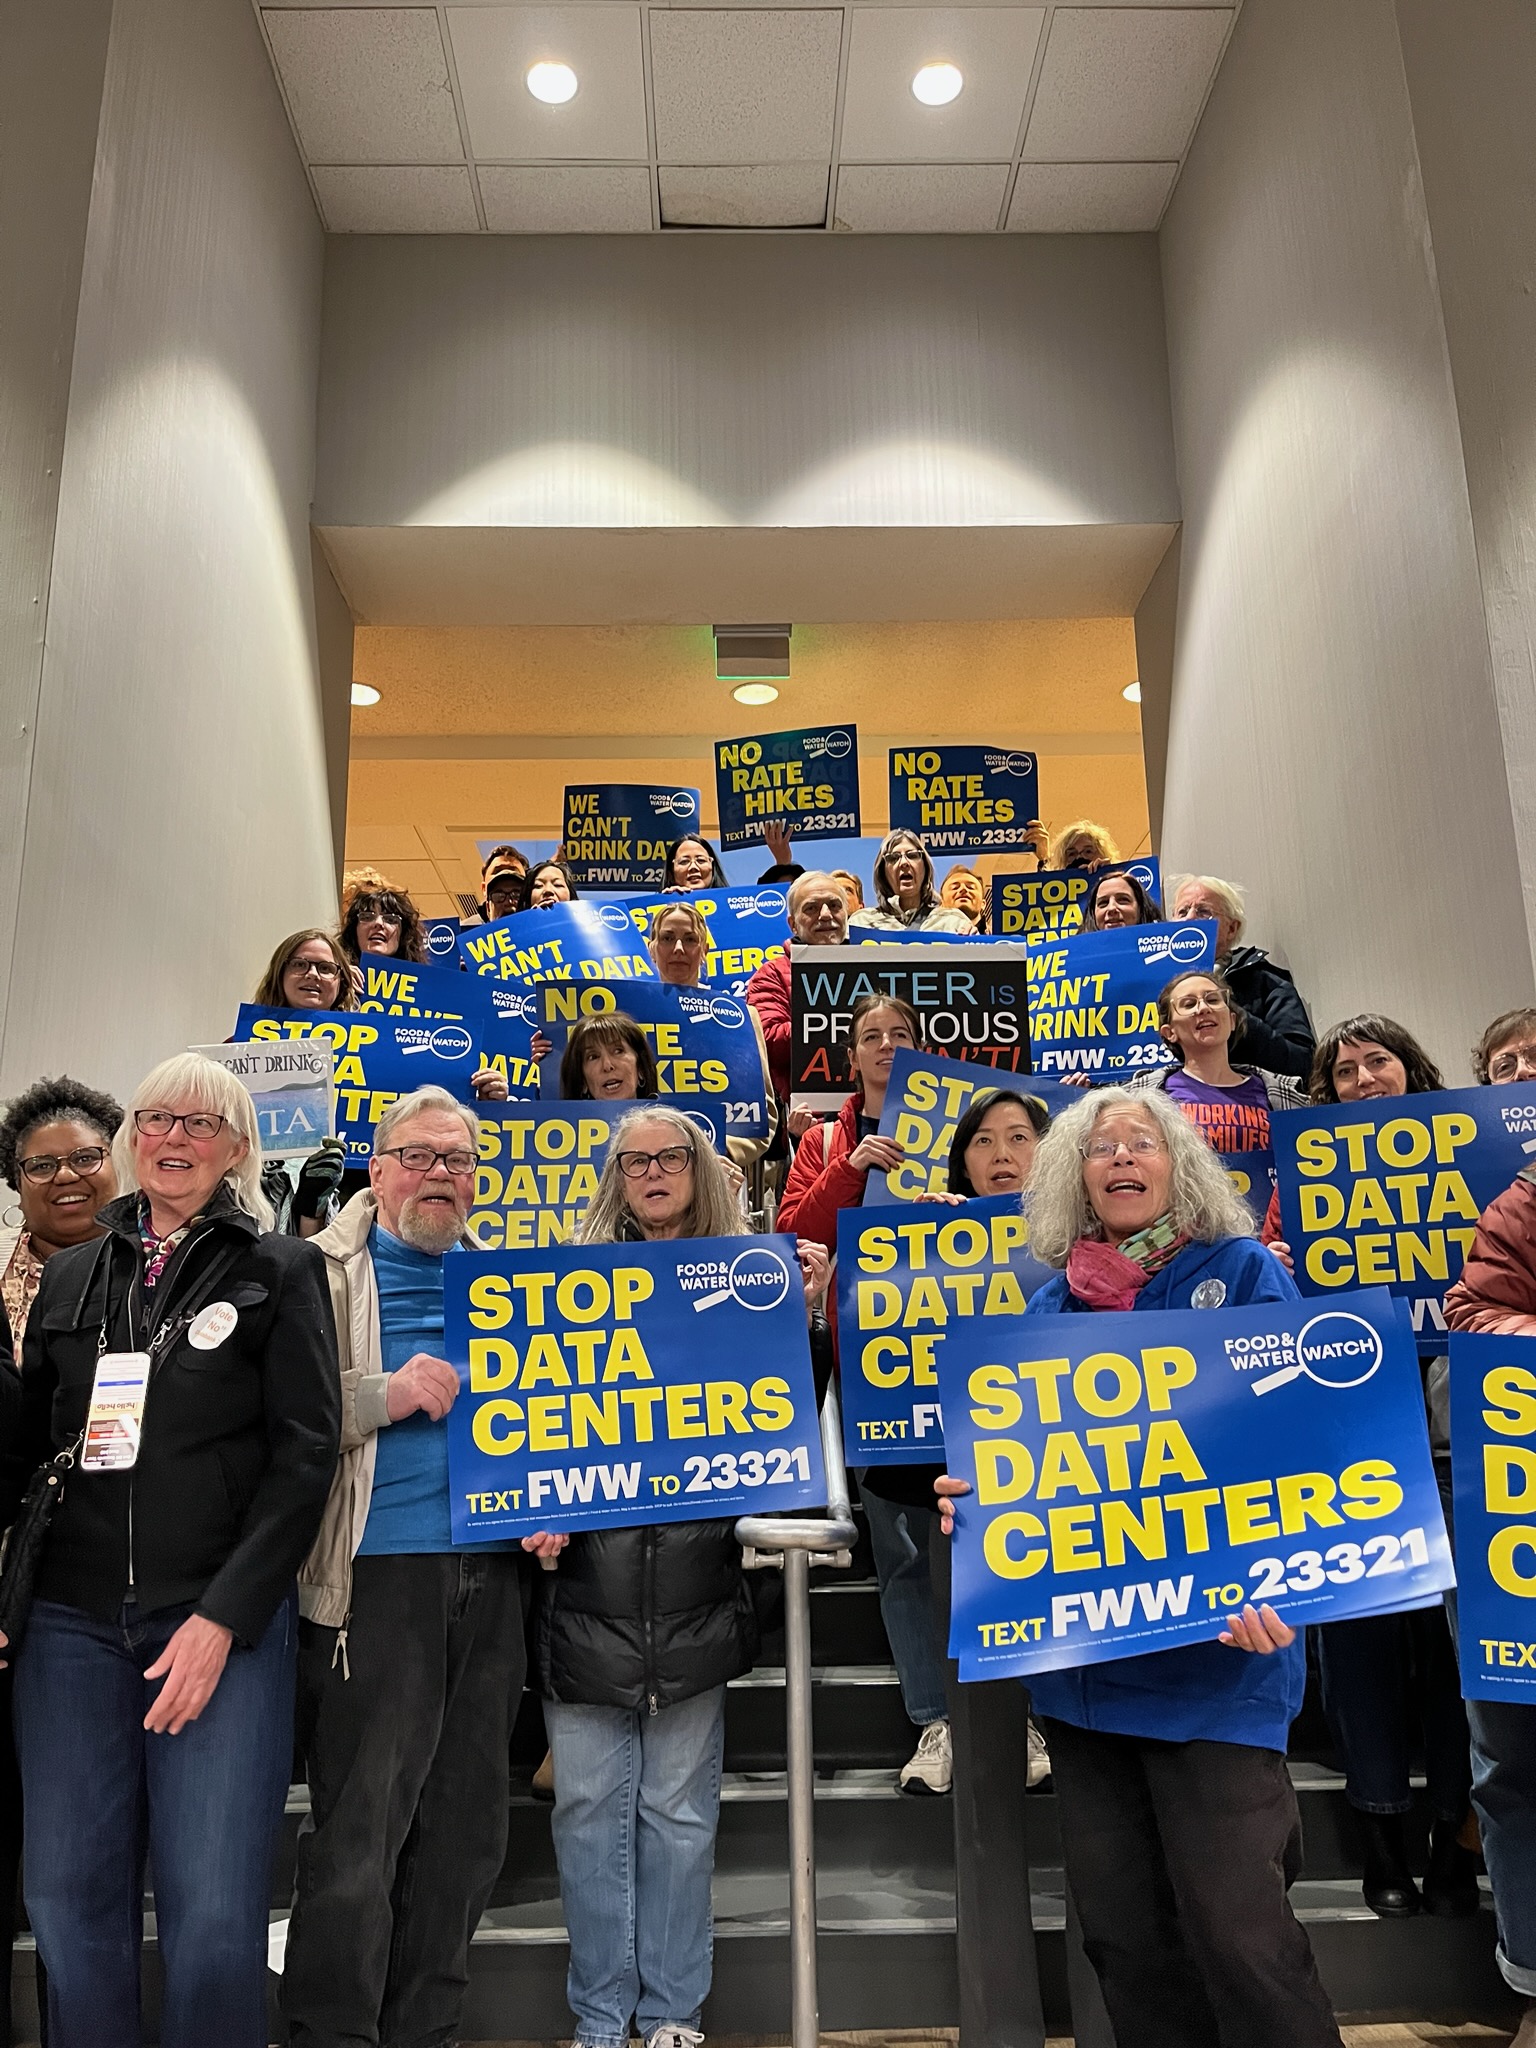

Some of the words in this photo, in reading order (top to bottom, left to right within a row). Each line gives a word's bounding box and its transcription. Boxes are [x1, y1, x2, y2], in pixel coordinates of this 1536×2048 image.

[719, 741, 763, 769] NO
[827, 740, 849, 748] WATCH
[732, 761, 804, 793] RATE
[894, 751, 941, 776] NO
[744, 784, 835, 817] HIKES
[908, 775, 984, 801] RATE
[568, 794, 599, 815] WE
[921, 799, 1015, 826] HIKES
[567, 817, 632, 838] CAN'T
[725, 831, 744, 841] TEXT
[803, 813, 855, 831] 23321
[920, 831, 965, 847] FWW
[968, 838, 981, 846] TO
[982, 828, 1026, 845] 2332
[566, 840, 632, 860] DRINK
[637, 840, 674, 861] DA
[588, 868, 629, 882] FWW
[631, 874, 643, 882] TO
[1002, 878, 1089, 907] STOP
[1002, 903, 1084, 933] DATA
[466, 928, 517, 964] WE
[1139, 944, 1168, 953] WATER
[1171, 939, 1204, 950] WATCH
[579, 955, 654, 981] DATA
[1026, 950, 1069, 982] WE
[367, 967, 418, 1003] WE
[801, 972, 978, 1006] WATER
[990, 985, 1016, 1005] IS
[1027, 973, 1110, 1011] CAN'T
[492, 998, 521, 1010] WATER
[545, 986, 617, 1023] NO
[680, 1004, 709, 1013] WATER
[712, 1006, 742, 1018] WATCH
[1117, 1002, 1160, 1035] DA
[249, 1020, 379, 1053] STOP
[395, 1035, 429, 1045] WATER
[433, 1038, 468, 1048] WATCH
[803, 1011, 1019, 1044] PRIOUS
[265, 1053, 323, 1074] DRINK
[1041, 1048, 1105, 1072] FWW
[1108, 1055, 1126, 1068] TO
[656, 1059, 729, 1094] KES
[258, 1106, 316, 1136] TA
[1180, 1103, 1270, 1132] WORKING
[1501, 1105, 1536, 1120] FOO
[349, 1141, 371, 1155] TO
[478, 1119, 610, 1160] STOP
[1296, 1113, 1477, 1177] STOP
[473, 1164, 600, 1206] DATA
[1299, 1170, 1481, 1233] DATA
[857, 1215, 1028, 1273] STOP
[1305, 1227, 1476, 1287] CENT
[679, 1274, 729, 1291] WATER
[733, 1272, 785, 1287] WATCH
[468, 1267, 654, 1330] STOP
[857, 1271, 1026, 1330] DATA
[468, 1327, 654, 1394] DATA
[1230, 1347, 1297, 1371] WATER
[1302, 1336, 1375, 1362] WATCH
[967, 1346, 1197, 1430] STOP
[472, 1377, 795, 1456] CENTERS
[857, 1421, 909, 1440] TEXT
[973, 1420, 1208, 1506] DATA
[466, 1490, 523, 1513] TEXT
[527, 1461, 641, 1507] FWW
[649, 1475, 680, 1496] TO
[683, 1446, 811, 1493] 23321
[982, 1459, 1404, 1580] CENTERS
[978, 1617, 1046, 1648] TEXT
[1051, 1574, 1194, 1638] FWW
[1203, 1583, 1244, 1610] TO
[1249, 1527, 1430, 1600] 23321
[1479, 1639, 1536, 1668] TEX
